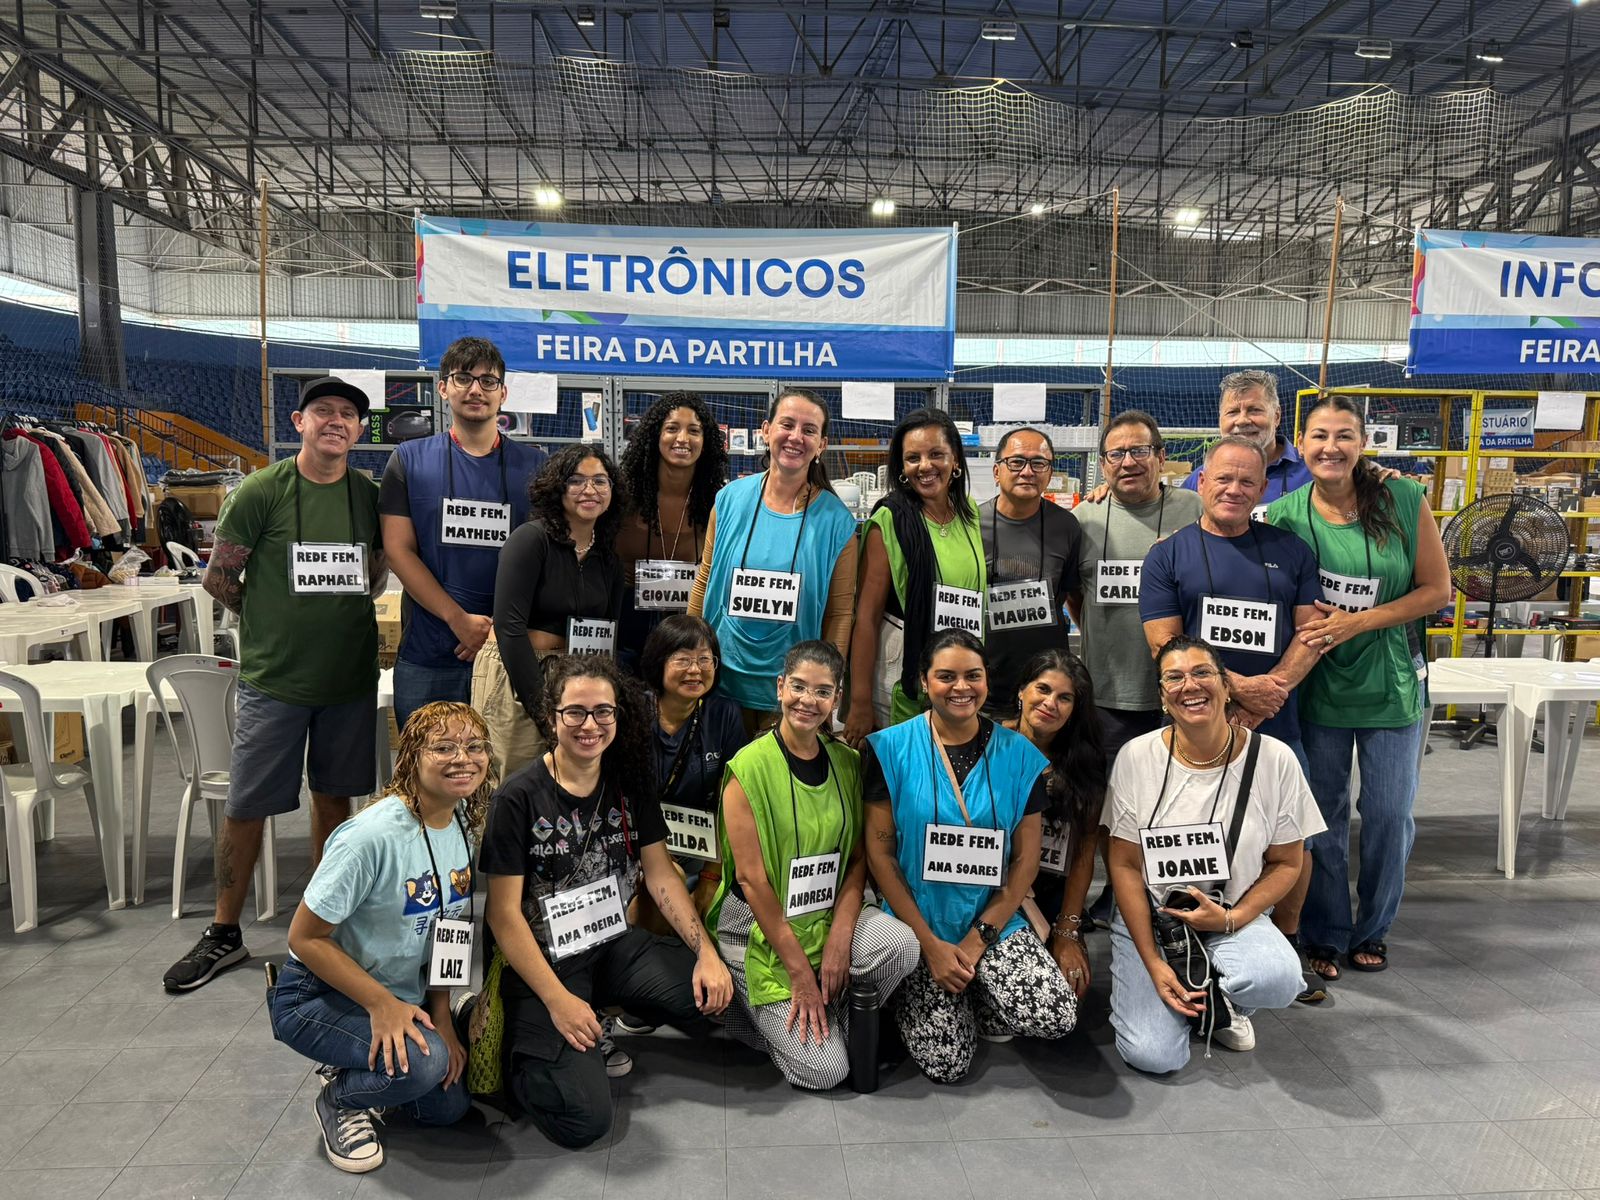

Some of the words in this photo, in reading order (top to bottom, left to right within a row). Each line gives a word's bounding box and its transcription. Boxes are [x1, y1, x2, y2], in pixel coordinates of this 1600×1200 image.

[507, 245, 866, 299] ELETRÔNICOS
[536, 334, 627, 363] FEIRA
[634, 337, 680, 364] DA
[687, 339, 838, 367] PARTILHA
[1519, 339, 1600, 363] FEIRA
[371, 414, 381, 443] BASS
[1482, 414, 1528, 428] STUÁRIO
[1486, 438, 1495, 446] DA
[1497, 437, 1532, 446] PARTILHA
[446, 504, 477, 517] REDE
[480, 507, 507, 520] FEM.
[445, 525, 507, 542] MATHEUS
[296, 551, 328, 563] REDE
[332, 551, 359, 563] FEM.
[297, 574, 362, 586] RAPHAEL
[1100, 565, 1129, 576] REDE
[735, 574, 766, 588] REDE
[769, 577, 796, 591] FEM.
[1318, 575, 1341, 591] EDE
[1344, 583, 1374, 596] FEM.
[938, 590, 960, 605] REDE
[961, 595, 981, 609] FEM.
[989, 589, 1017, 603] REDE
[1020, 586, 1046, 599] FEM.
[732, 596, 794, 616] SUELYN
[1206, 603, 1239, 617] REDE
[1243, 607, 1272, 622] FEM.
[937, 614, 980, 632] ANGELICA
[993, 606, 1047, 626] MAURO
[572, 625, 594, 638] REDE
[595, 626, 612, 639] FEM.
[1209, 626, 1266, 647] EDSON
[663, 810, 685, 823] EDE
[687, 814, 712, 829] FEM.
[930, 831, 964, 847] REDE
[968, 835, 1000, 850] FEM.
[1145, 834, 1182, 849] REDE
[1186, 831, 1220, 846] FEM.
[791, 863, 815, 879] REDE
[816, 860, 836, 876] FEM.
[927, 860, 953, 873] ANA
[955, 863, 999, 877] SOARES
[1157, 857, 1219, 878] JOANE
[789, 886, 833, 909] ANDRESA
[436, 927, 455, 944] REDE
[456, 929, 471, 945] FEM.
[557, 928, 582, 947] ANA
[583, 912, 622, 936] BOEIRA
[440, 958, 464, 979] LAIZ
